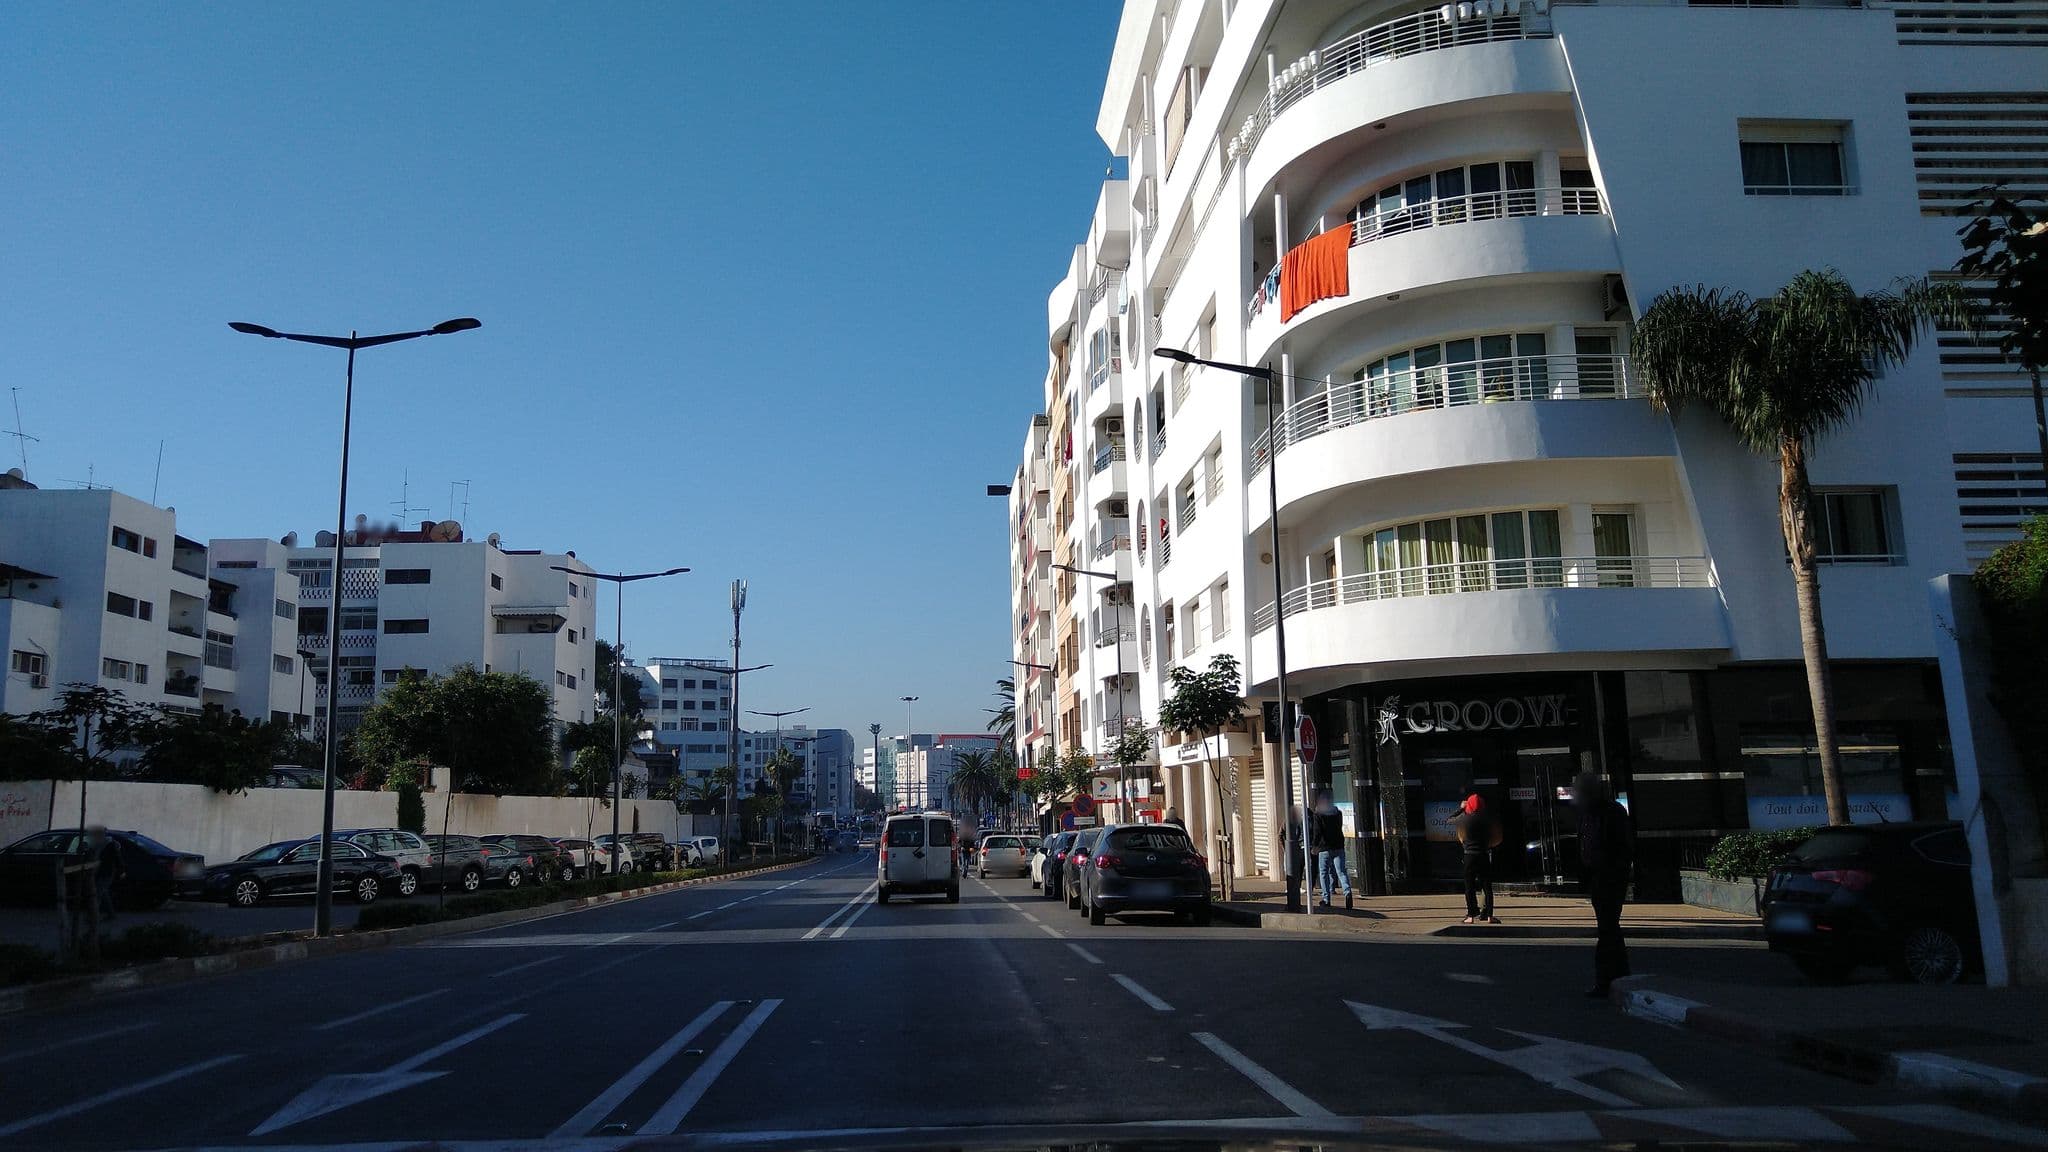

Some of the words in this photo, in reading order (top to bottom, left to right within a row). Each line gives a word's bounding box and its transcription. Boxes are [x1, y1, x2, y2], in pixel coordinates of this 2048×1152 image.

[1406, 694, 1567, 734] GROOVY
[1764, 801, 1792, 816] Tout
[1796, 799, 1819, 815] doit
